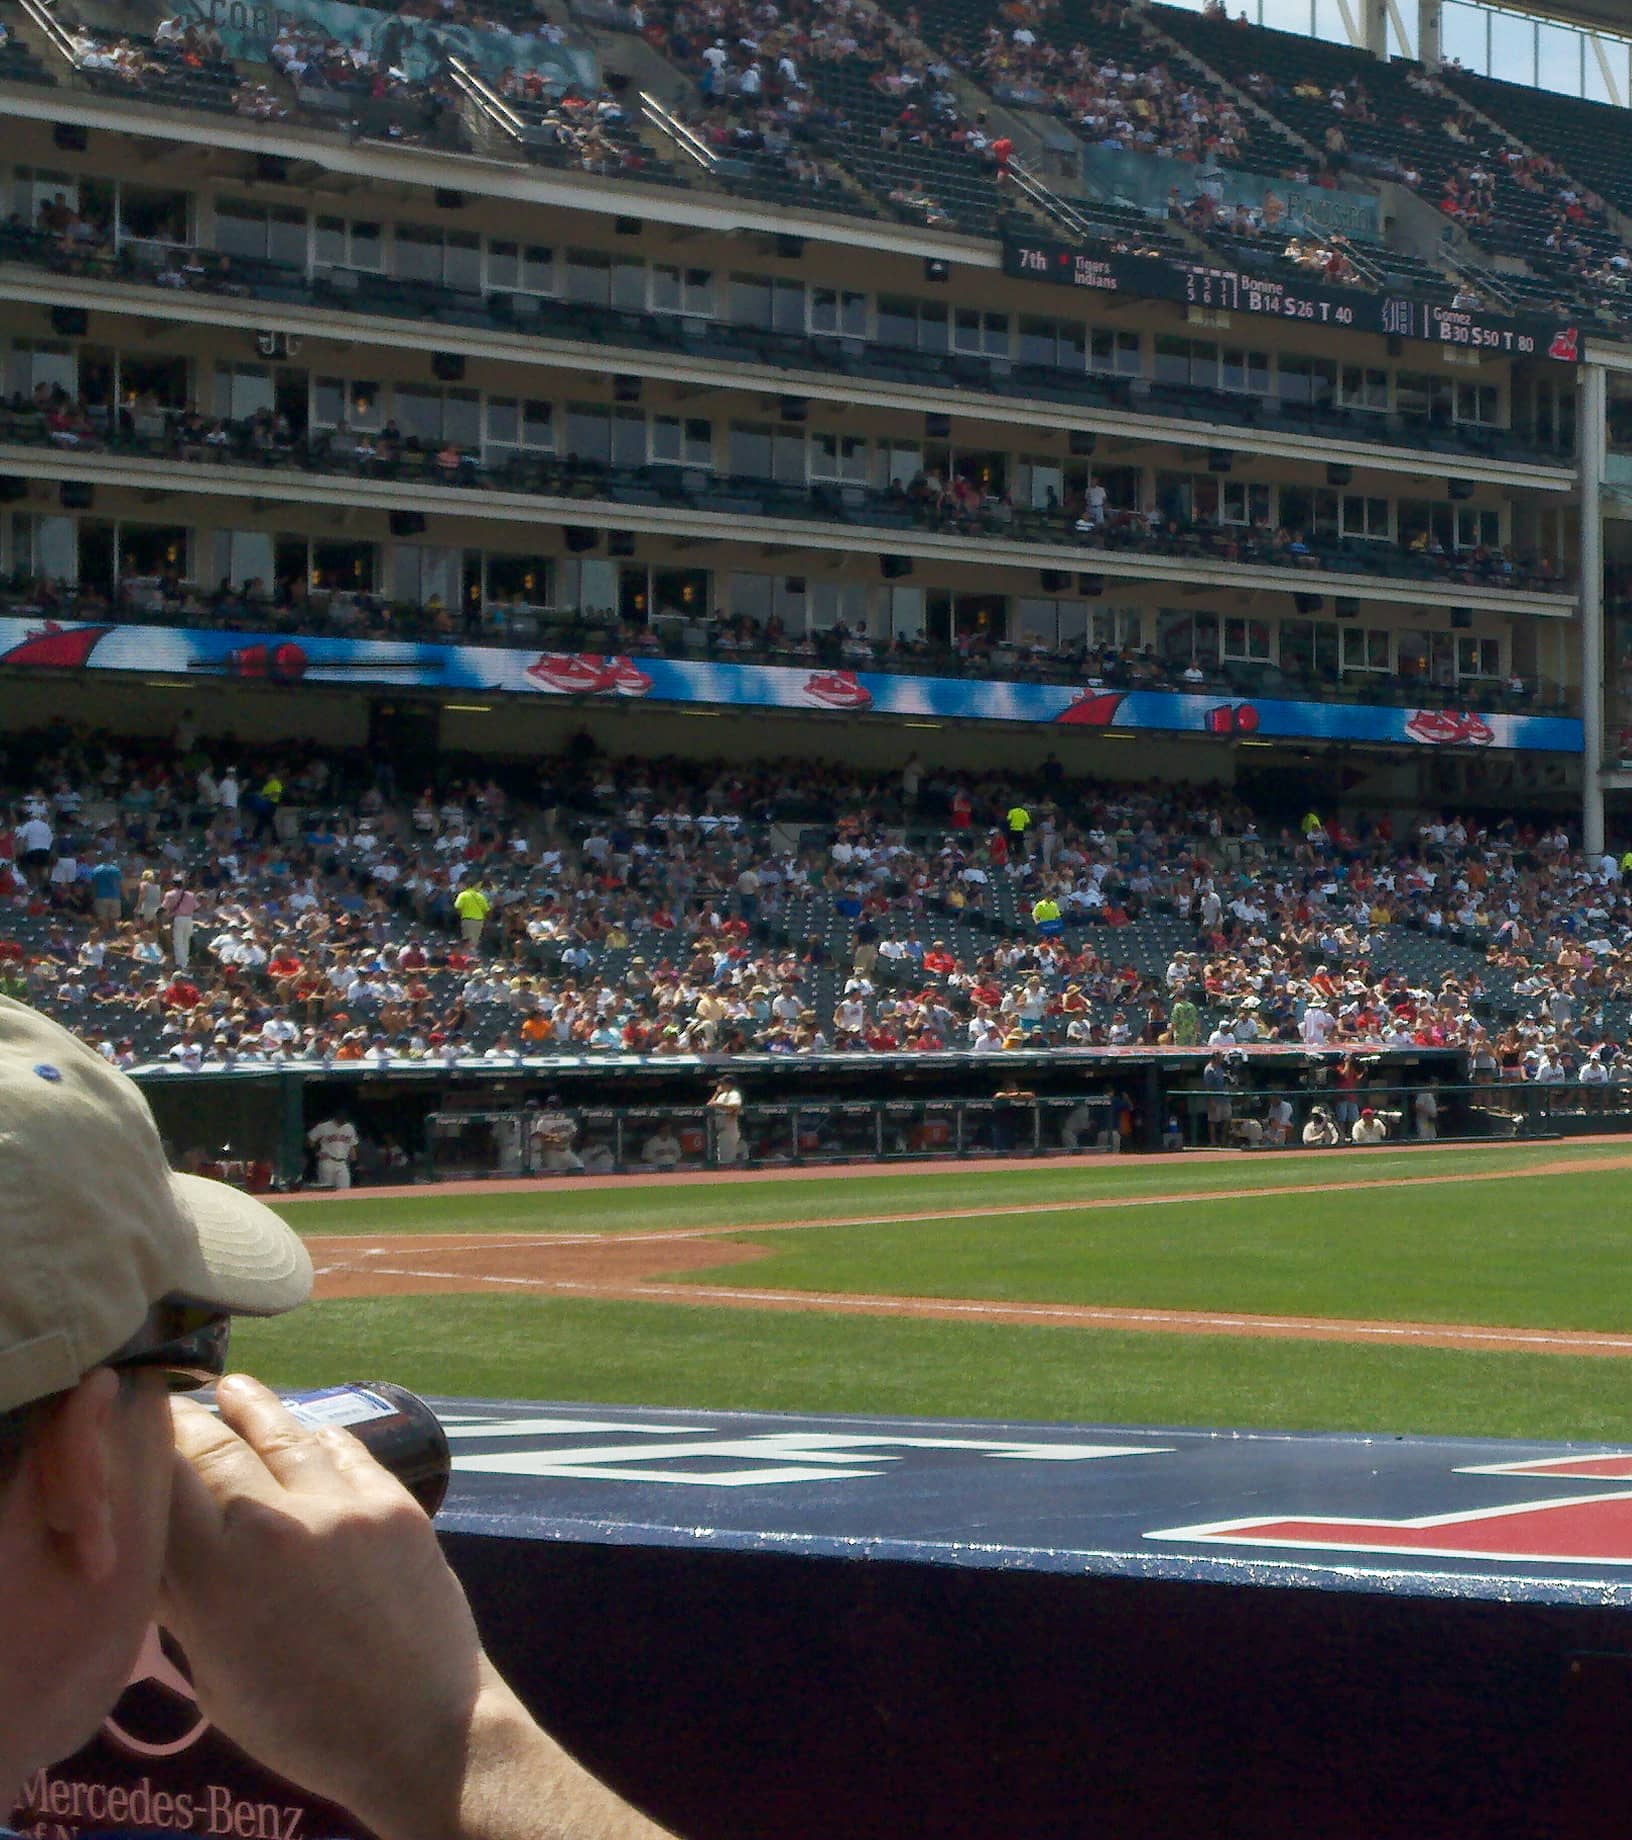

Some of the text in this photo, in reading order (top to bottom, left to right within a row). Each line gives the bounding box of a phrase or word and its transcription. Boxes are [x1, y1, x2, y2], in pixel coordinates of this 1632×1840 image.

[1018, 248, 1047, 271] 7th
[1074, 255, 1111, 274] Tigers
[1074, 269, 1117, 289] Indians
[1241, 275, 1284, 294] Bonine
[1434, 306, 1472, 325] Gomez
[13, 1767, 304, 1840] Mercedes-Benz
